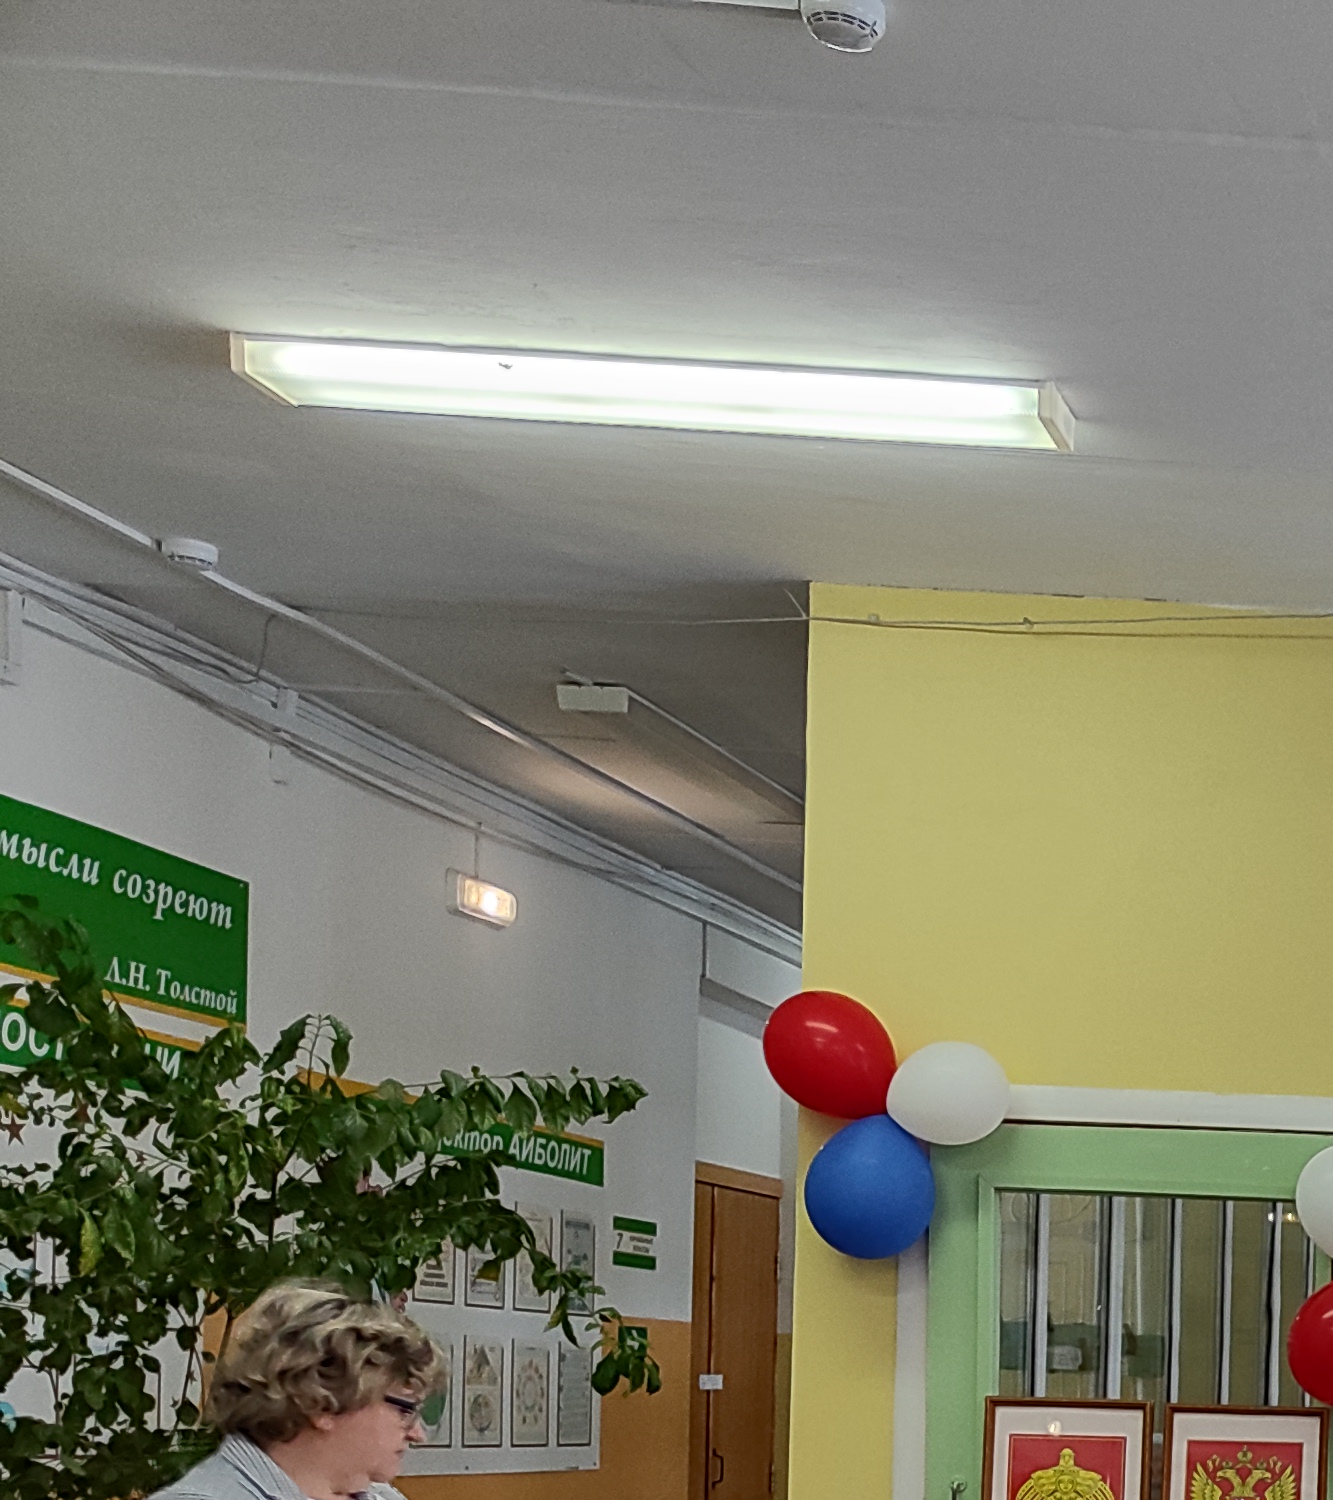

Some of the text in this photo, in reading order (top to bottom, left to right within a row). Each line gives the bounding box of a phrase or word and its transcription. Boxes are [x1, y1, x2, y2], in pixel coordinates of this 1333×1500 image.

[0, 830, 233, 929] мысли созреют
[104, 956, 238, 1014] Л.Н. Толстой
